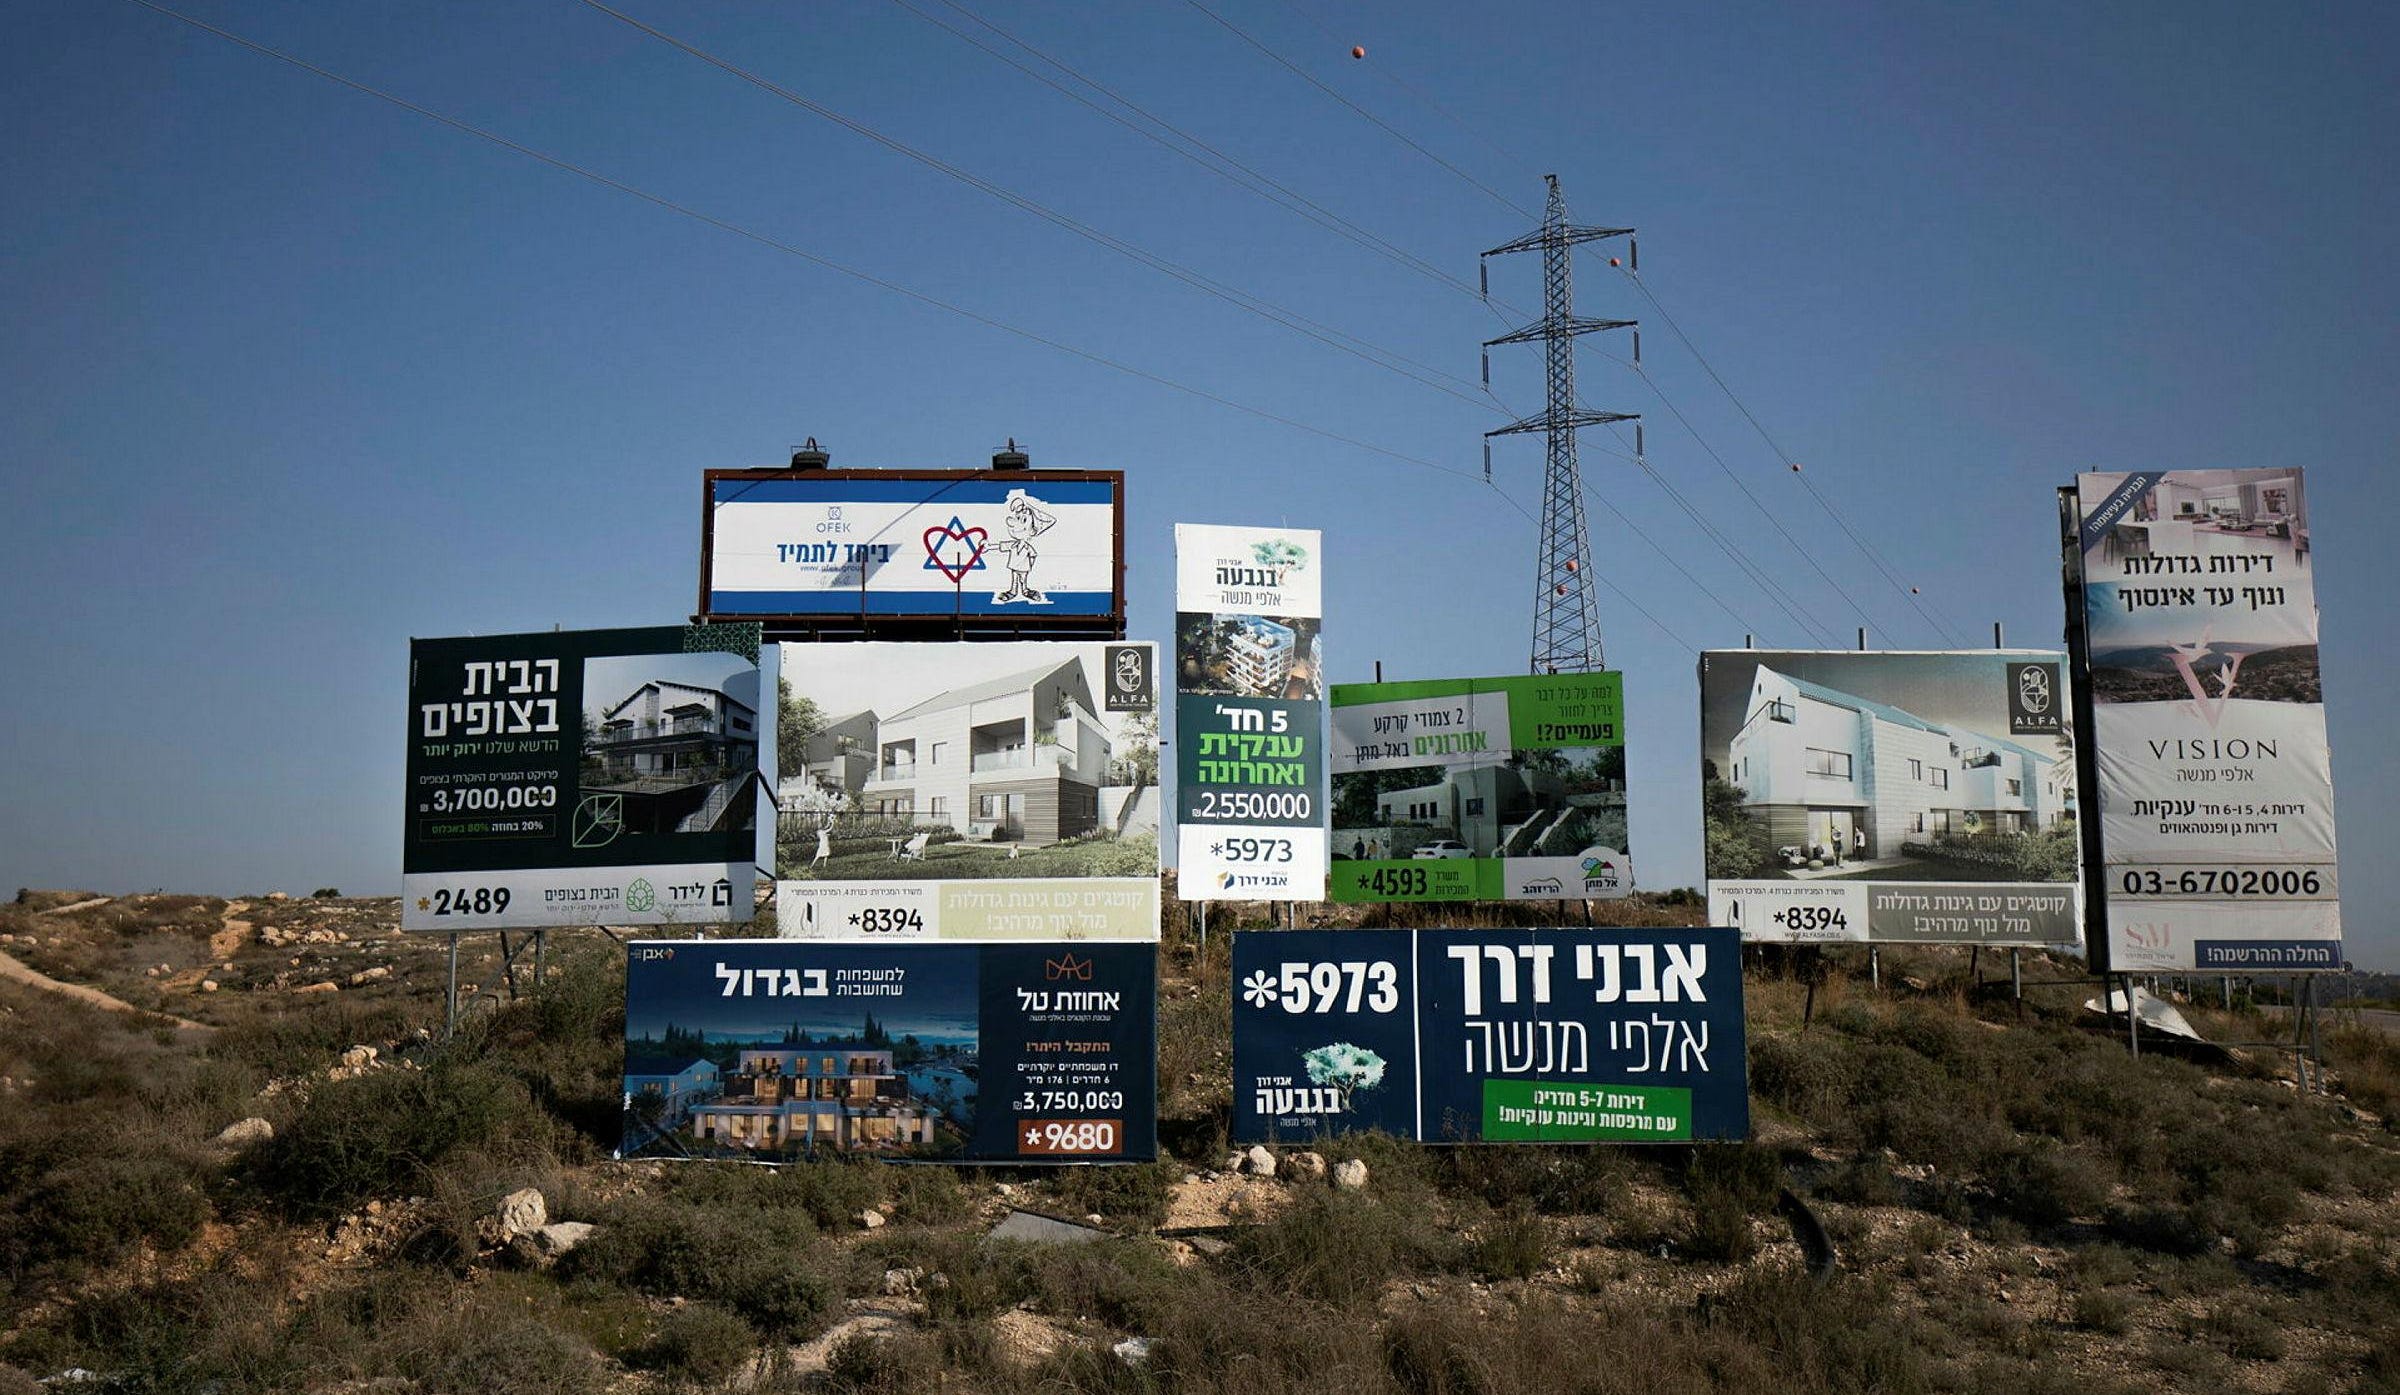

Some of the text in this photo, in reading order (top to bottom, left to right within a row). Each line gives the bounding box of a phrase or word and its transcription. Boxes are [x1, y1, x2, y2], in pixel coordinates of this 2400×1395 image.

[816, 522, 851, 533] OFEK
[777, 540, 889, 562] ביחד לתמיד
[2123, 551, 2274, 575] דירות גדולות
[1216, 567, 1278, 587] בגבעה
[1221, 590, 1282, 606] אלפי מנשה
[2118, 587, 2286, 612] ונוף עד אינסוף
[463, 658, 559, 696] הבית
[1110, 695, 1148, 703] ALFA
[421, 699, 559, 737] בצופים
[1215, 704, 1288, 733] 5 חד'
[1374, 708, 1464, 733] 2 צמודי קרקע
[2015, 716, 2057, 725] ALFA
[1537, 723, 1614, 742] פעמיים?!
[422, 740, 559, 757] הדשא שלנו ירוק יותר
[1199, 733, 1304, 761] ענקית
[1355, 730, 1487, 763] אחרונים באל מתן
[2149, 739, 2278, 760] VISION
[527, 770, 559, 781] פרויקט
[1199, 760, 1305, 785] ואחרונה
[2176, 766, 2254, 782] אלפי מנשה
[433, 785, 556, 813] 3,700,000
[2246, 805, 2253, 815] 5
[2273, 804, 2305, 815] דירות
[492, 822, 519, 832] בחוזה
[521, 821, 544, 831] 20%
[2160, 822, 2278, 837] דירות גן ופנטהאוזים
[1238, 876, 1288, 887] אבני דרך
[1585, 879, 1618, 892] אל מתן
[2123, 870, 2321, 895] 03-6702006
[544, 887, 619, 902] הבית בצופים
[669, 882, 705, 899] לידר
[949, 890, 1004, 908] גדולות
[1008, 891, 1049, 908] גינות
[1054, 892, 1079, 908] עם
[1876, 891, 1930, 911] גדולות
[1933, 895, 1974, 911] גינות
[1978, 896, 2002, 912] עם
[988, 914, 1044, 931] מרהיב!
[1079, 912, 1107, 929] מול
[1914, 914, 2031, 936] מול נוף מרהיב!
[642, 949, 664, 962] אבן
[2207, 944, 2330, 963] החלה ההרשמה!
[715, 962, 829, 997] בגדול
[835, 966, 905, 982] למשפחות
[1447, 944, 1708, 1015] אבני דרך
[836, 983, 903, 996] שחושבות
[1017, 987, 1120, 1011] אחוזת טל
[1026, 1040, 1111, 1054] התקבל היתר!
[1465, 1013, 1710, 1074] אלפי מנשה
[1058, 1063, 1106, 1071] משפחתיים
[1109, 1063, 1119, 1071] דו
[1047, 1076, 1063, 1084] 176
[1072, 1076, 1101, 1084] חדרים
[1104, 1076, 1110, 1084] 6
[1256, 1077, 1292, 1087] אבני דרך
[1256, 1088, 1340, 1115] בגבעה
[1580, 1091, 1604, 1107] 5-7
[1607, 1093, 1645, 1110] דירות
[1556, 1111, 1595, 1127] וגינות
[1599, 1113, 1652, 1130] מרפסות
[1656, 1117, 1677, 1131] עם
